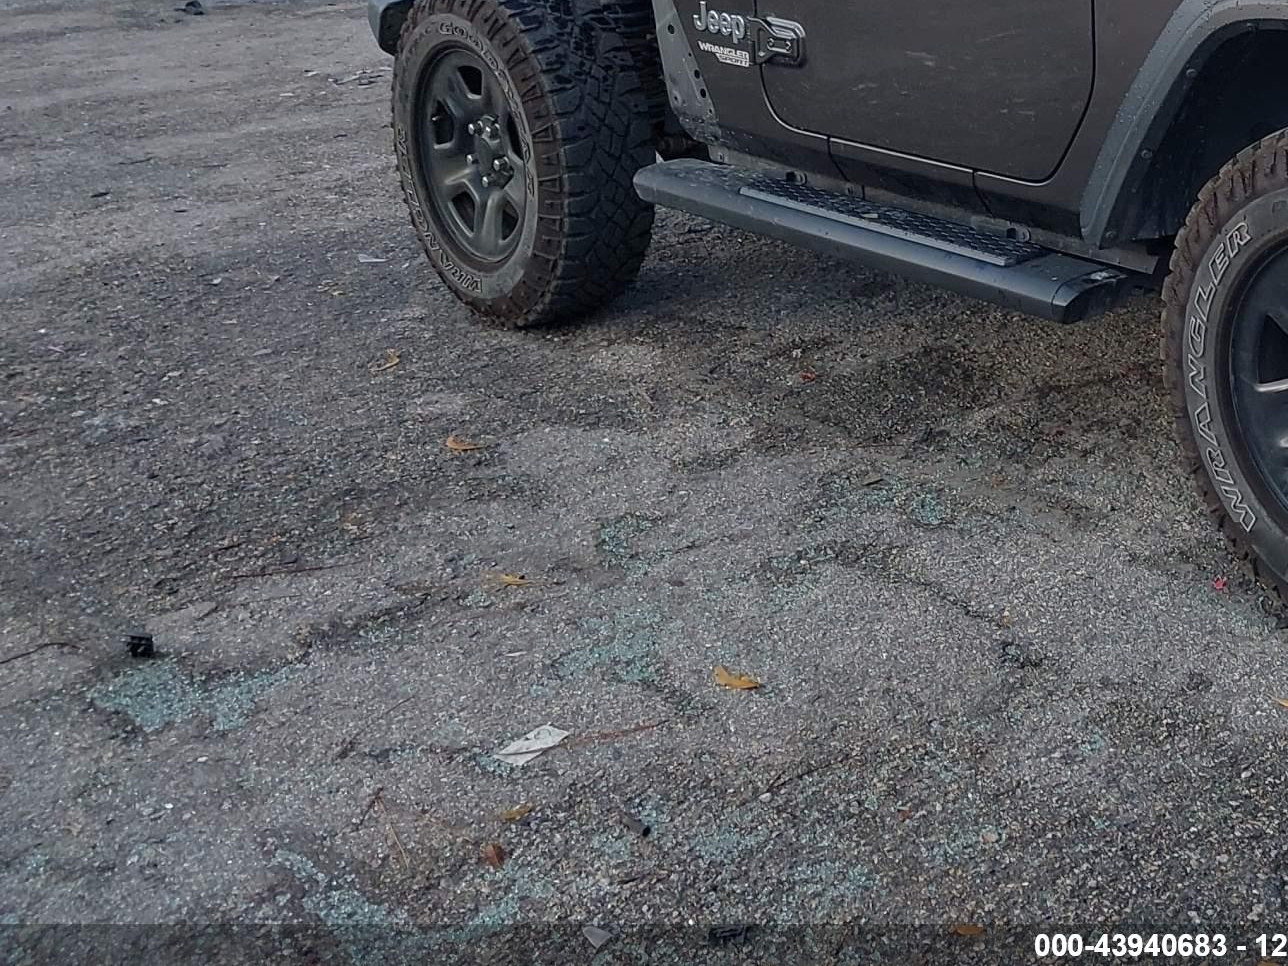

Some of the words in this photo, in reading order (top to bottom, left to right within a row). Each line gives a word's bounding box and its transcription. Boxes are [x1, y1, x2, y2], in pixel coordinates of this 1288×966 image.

[692, 0, 746, 44] Jeep
[697, 40, 750, 59] WRANGLER
[1185, 221, 1253, 534] WRANGLER
